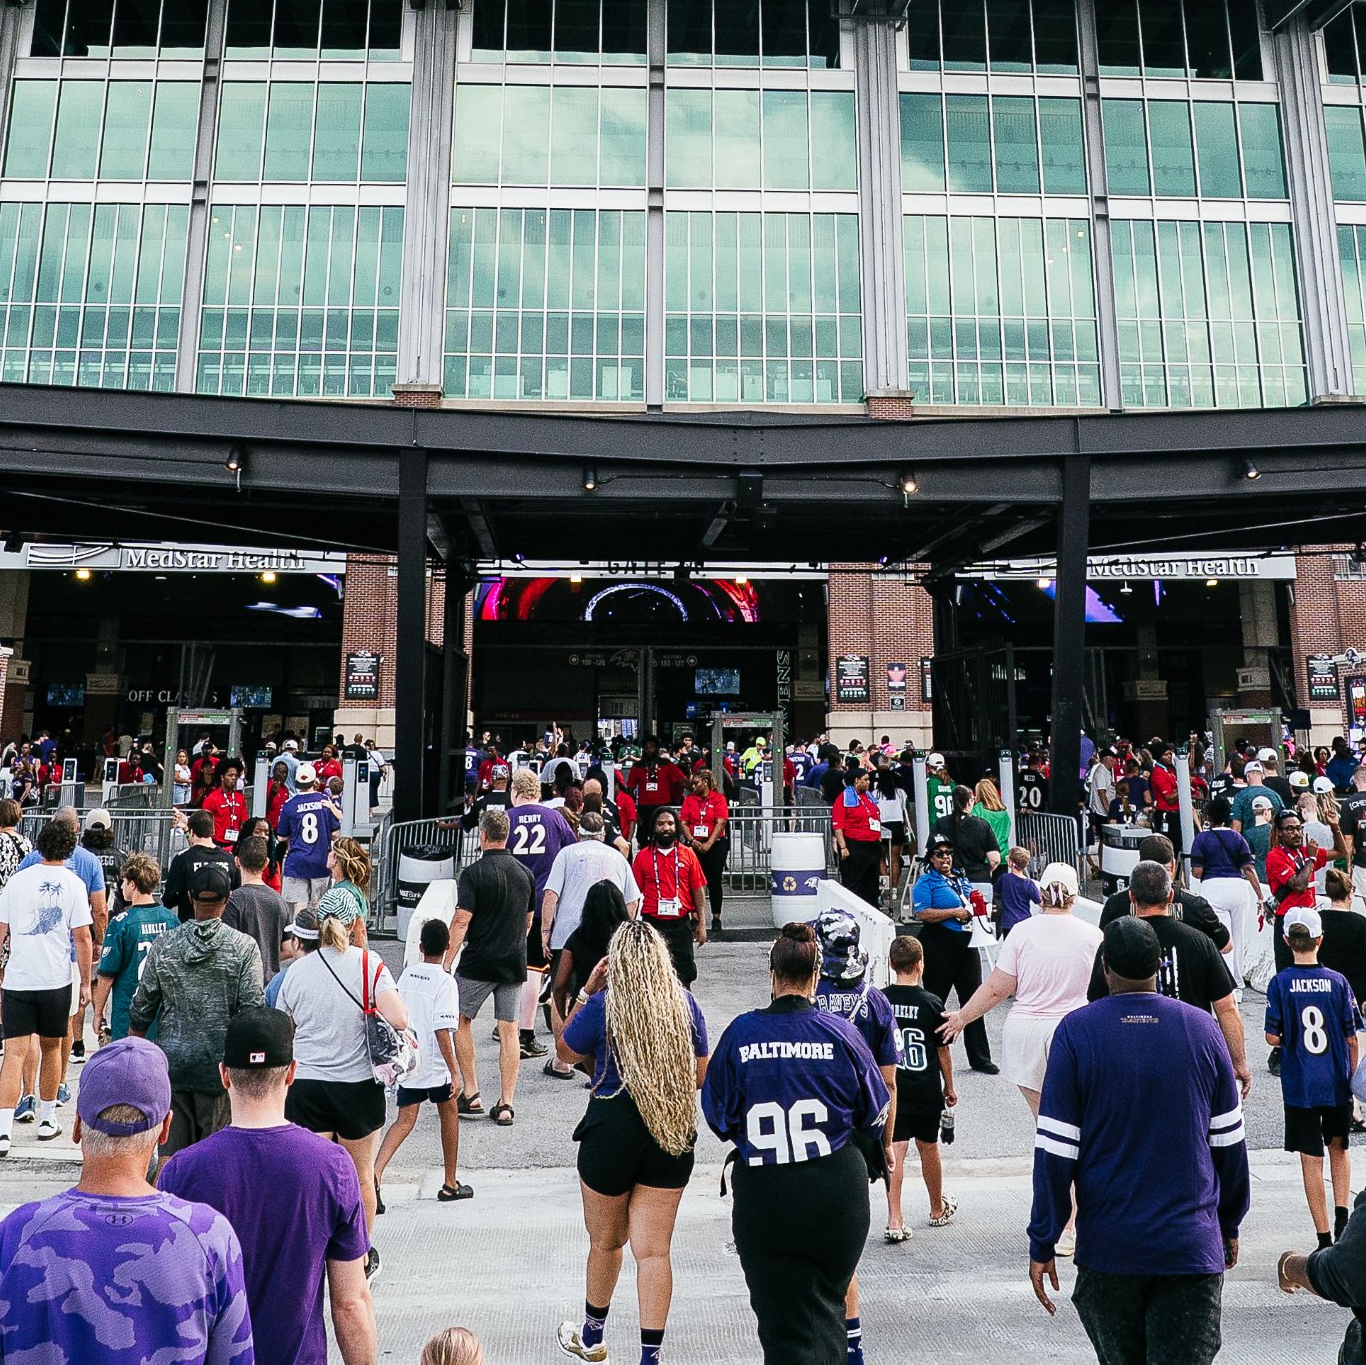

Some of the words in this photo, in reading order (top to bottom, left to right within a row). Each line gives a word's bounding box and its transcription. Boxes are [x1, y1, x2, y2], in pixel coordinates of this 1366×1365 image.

[126, 548, 222, 570] MedStar
[227, 549, 305, 571] Health
[1089, 555, 1179, 577] MedStar
[1185, 557, 1259, 577] Health
[1019, 787, 1042, 808] 20
[301, 812, 319, 844] 8
[518, 814, 542, 824] HENRY
[512, 823, 547, 855] 22
[1289, 978, 1333, 993] JACKSON
[1301, 1005, 1329, 1055] 8
[738, 1041, 835, 1063] BALTIMORE
[746, 1098, 833, 1167] 96
